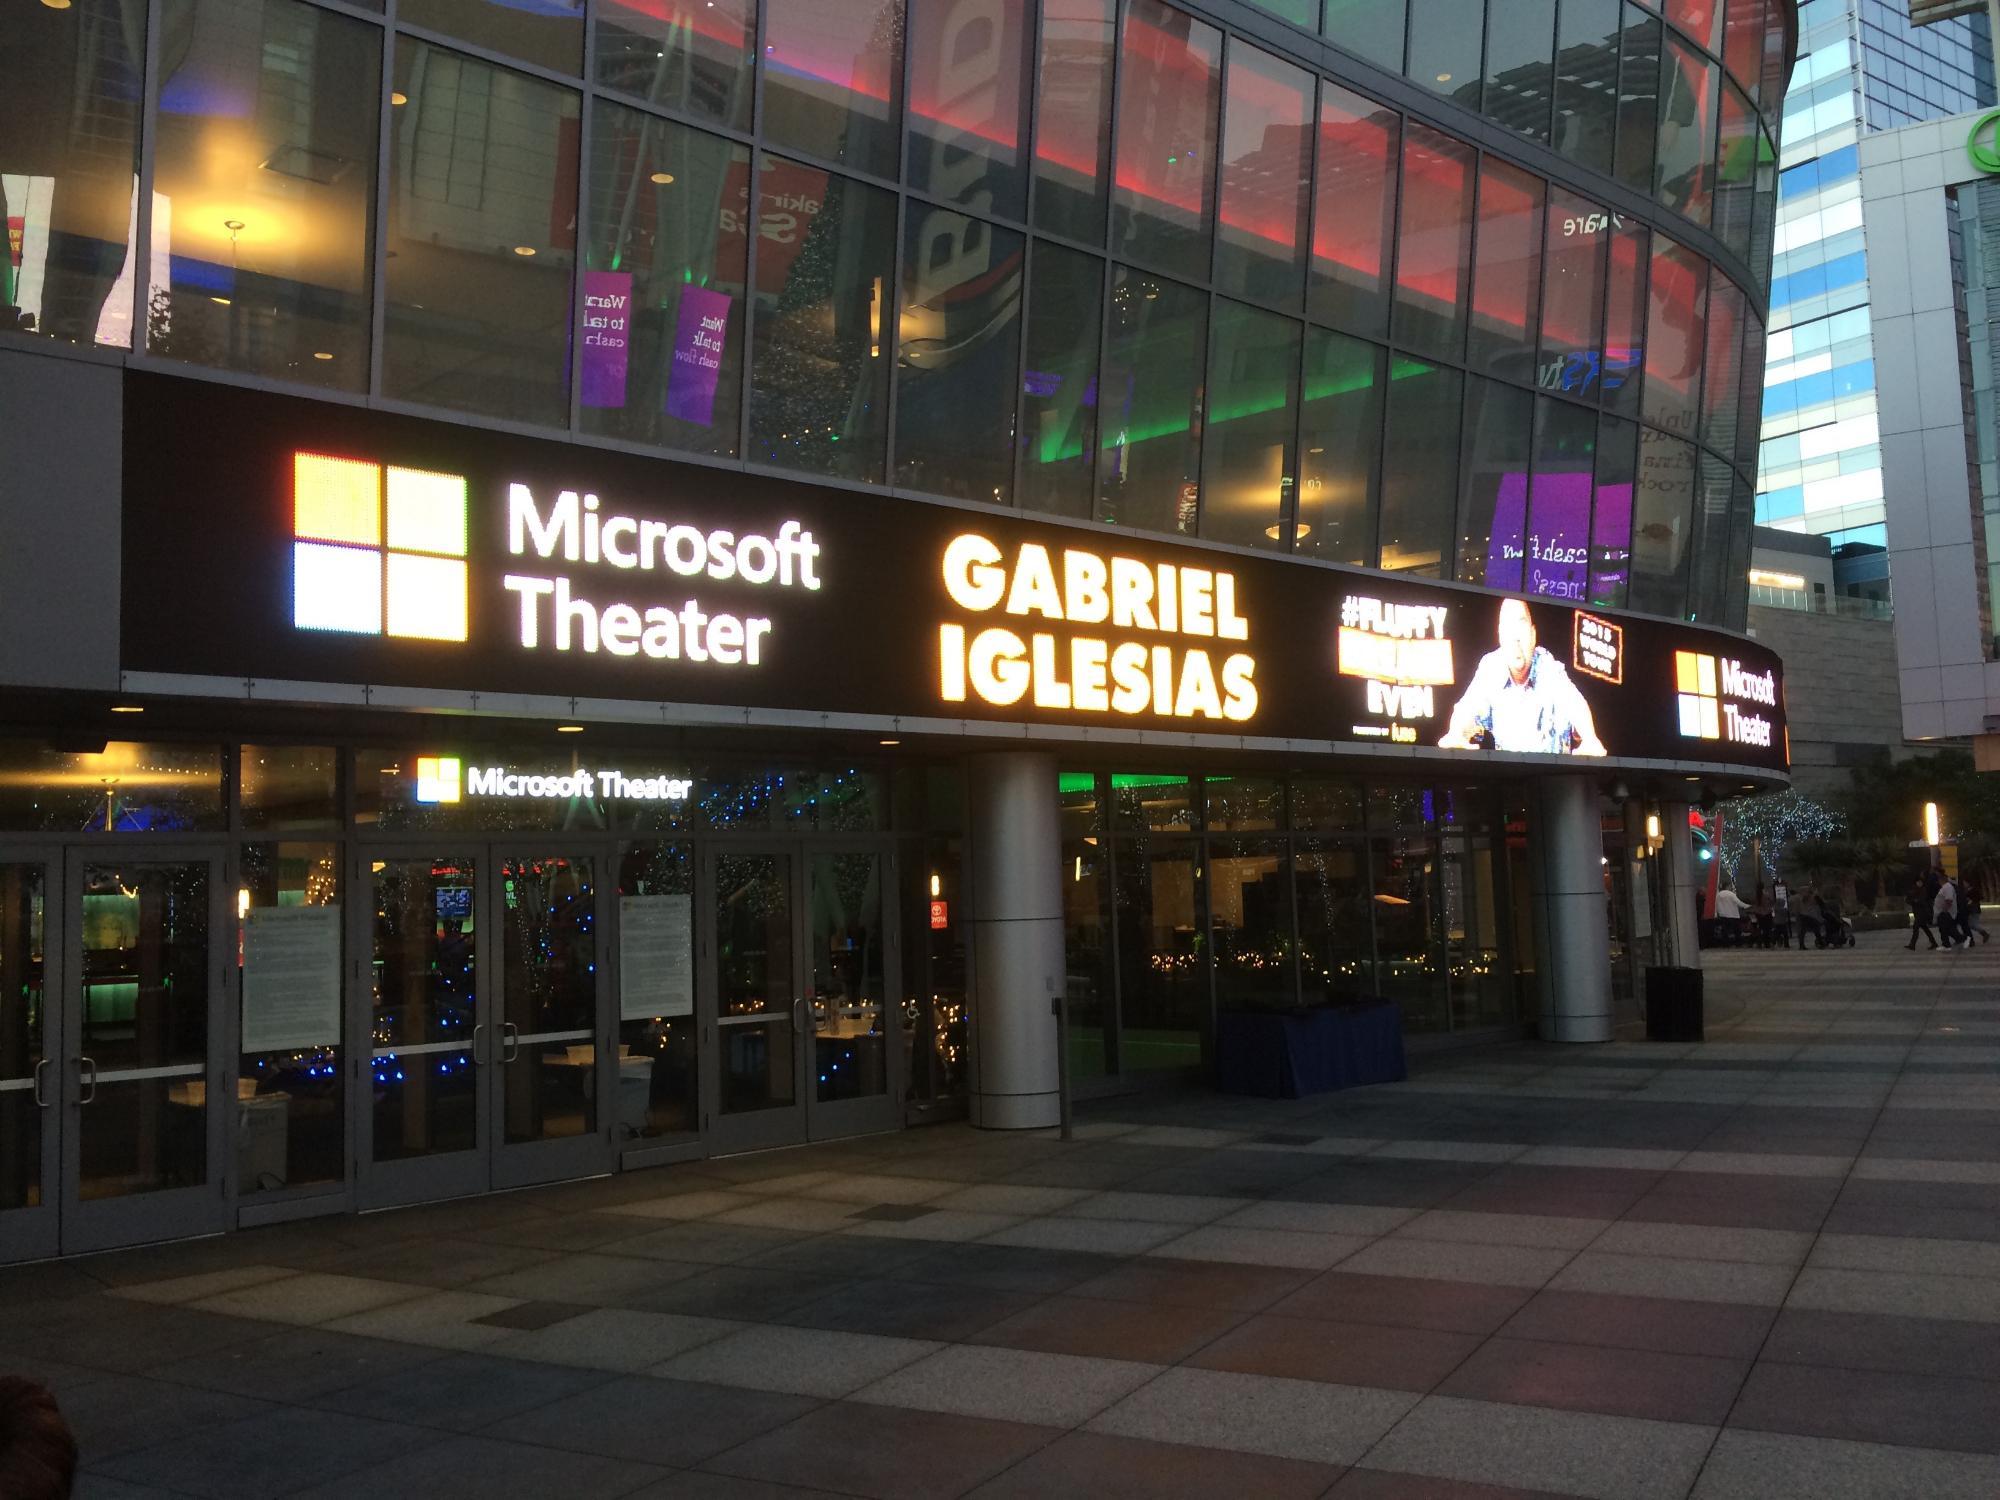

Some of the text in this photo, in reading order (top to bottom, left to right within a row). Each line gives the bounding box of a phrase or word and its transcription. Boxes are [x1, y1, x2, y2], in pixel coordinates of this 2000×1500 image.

[508, 482, 821, 591] Microsoft
[942, 533, 1249, 641] GABRIEL
[504, 574, 772, 665] Theater
[1341, 595, 1447, 639] #FLUFFY
[940, 623, 1259, 721] IGLESIAS
[1721, 657, 1776, 707] Microsoft
[1367, 680, 1434, 719] EVEN
[1724, 703, 1771, 747] Theater
[467, 766, 693, 800] Microsoft Theater
